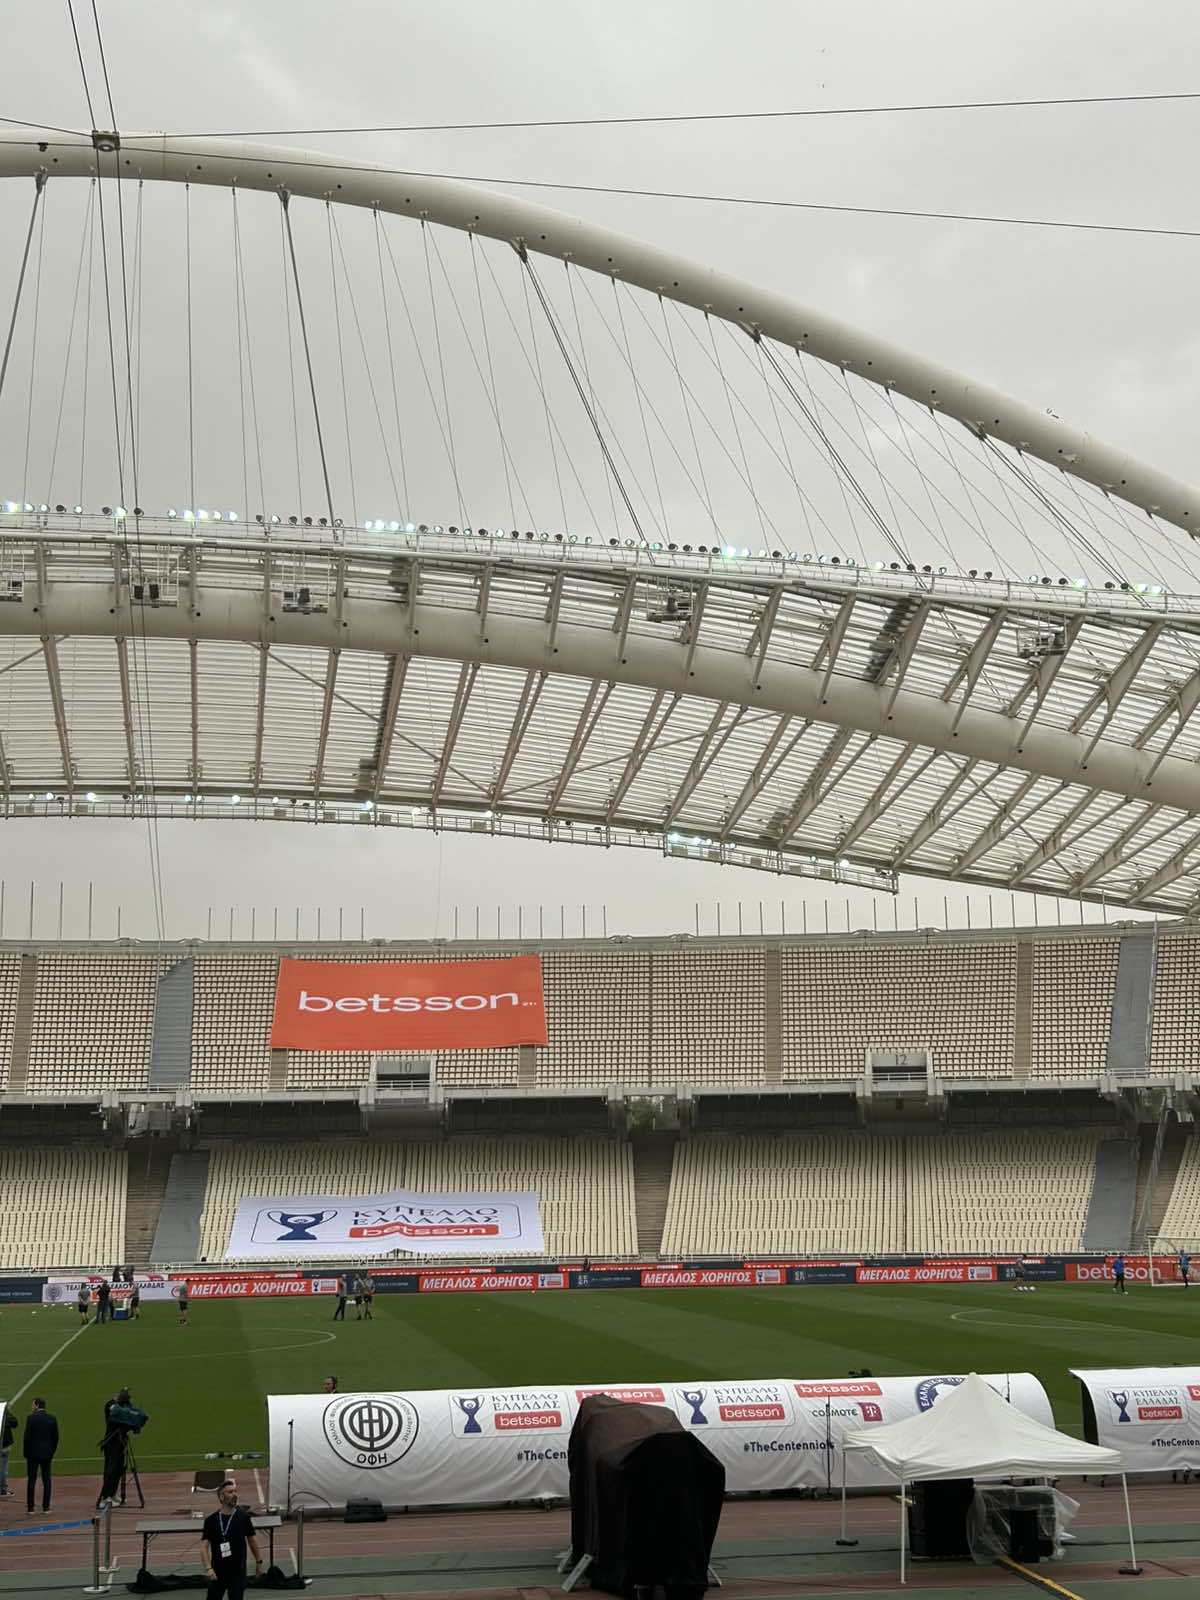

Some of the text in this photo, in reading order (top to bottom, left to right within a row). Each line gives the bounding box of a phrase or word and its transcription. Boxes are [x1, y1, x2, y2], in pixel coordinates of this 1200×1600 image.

[299, 991, 518, 1012] betsson
[895, 1054, 907, 1065] 12
[400, 1061, 412, 1073] 10
[363, 1225, 486, 1236] betsson
[859, 1269, 911, 1281] ΜΕΓΑΛΟΣ
[914, 1268, 963, 1280] ΧΟΡΗΓΟΣ
[1077, 1263, 1161, 1280] betson
[423, 1276, 477, 1289] ΜΕΓΑΛΟΣ
[481, 1275, 534, 1288] ΧΟΡΗΓΟΣ
[644, 1272, 697, 1285] ΜΕΓΑΛΟΣ
[701, 1271, 752, 1283] ΧΟΡΗΓΟΣ
[191, 1281, 307, 1295] ΜΕΓΑΛΟΣ ΧΟΡΗΓΟΣ
[714, 1386, 778, 1395] ΚΥΠΕΛΛΟ
[800, 1385, 871, 1393] betsson
[492, 1393, 558, 1402] ΚΥΠΕΛΛΟ
[716, 1394, 780, 1404] ΕΛΛΑΔΑΣ
[493, 1401, 560, 1411] ΕΛΛΑΔΑΣ
[724, 1408, 780, 1418] betsson
[500, 1415, 557, 1426] betsson
[743, 1441, 835, 1453] #TheCentennias
[357, 1453, 388, 1465] ΟΦΗ
